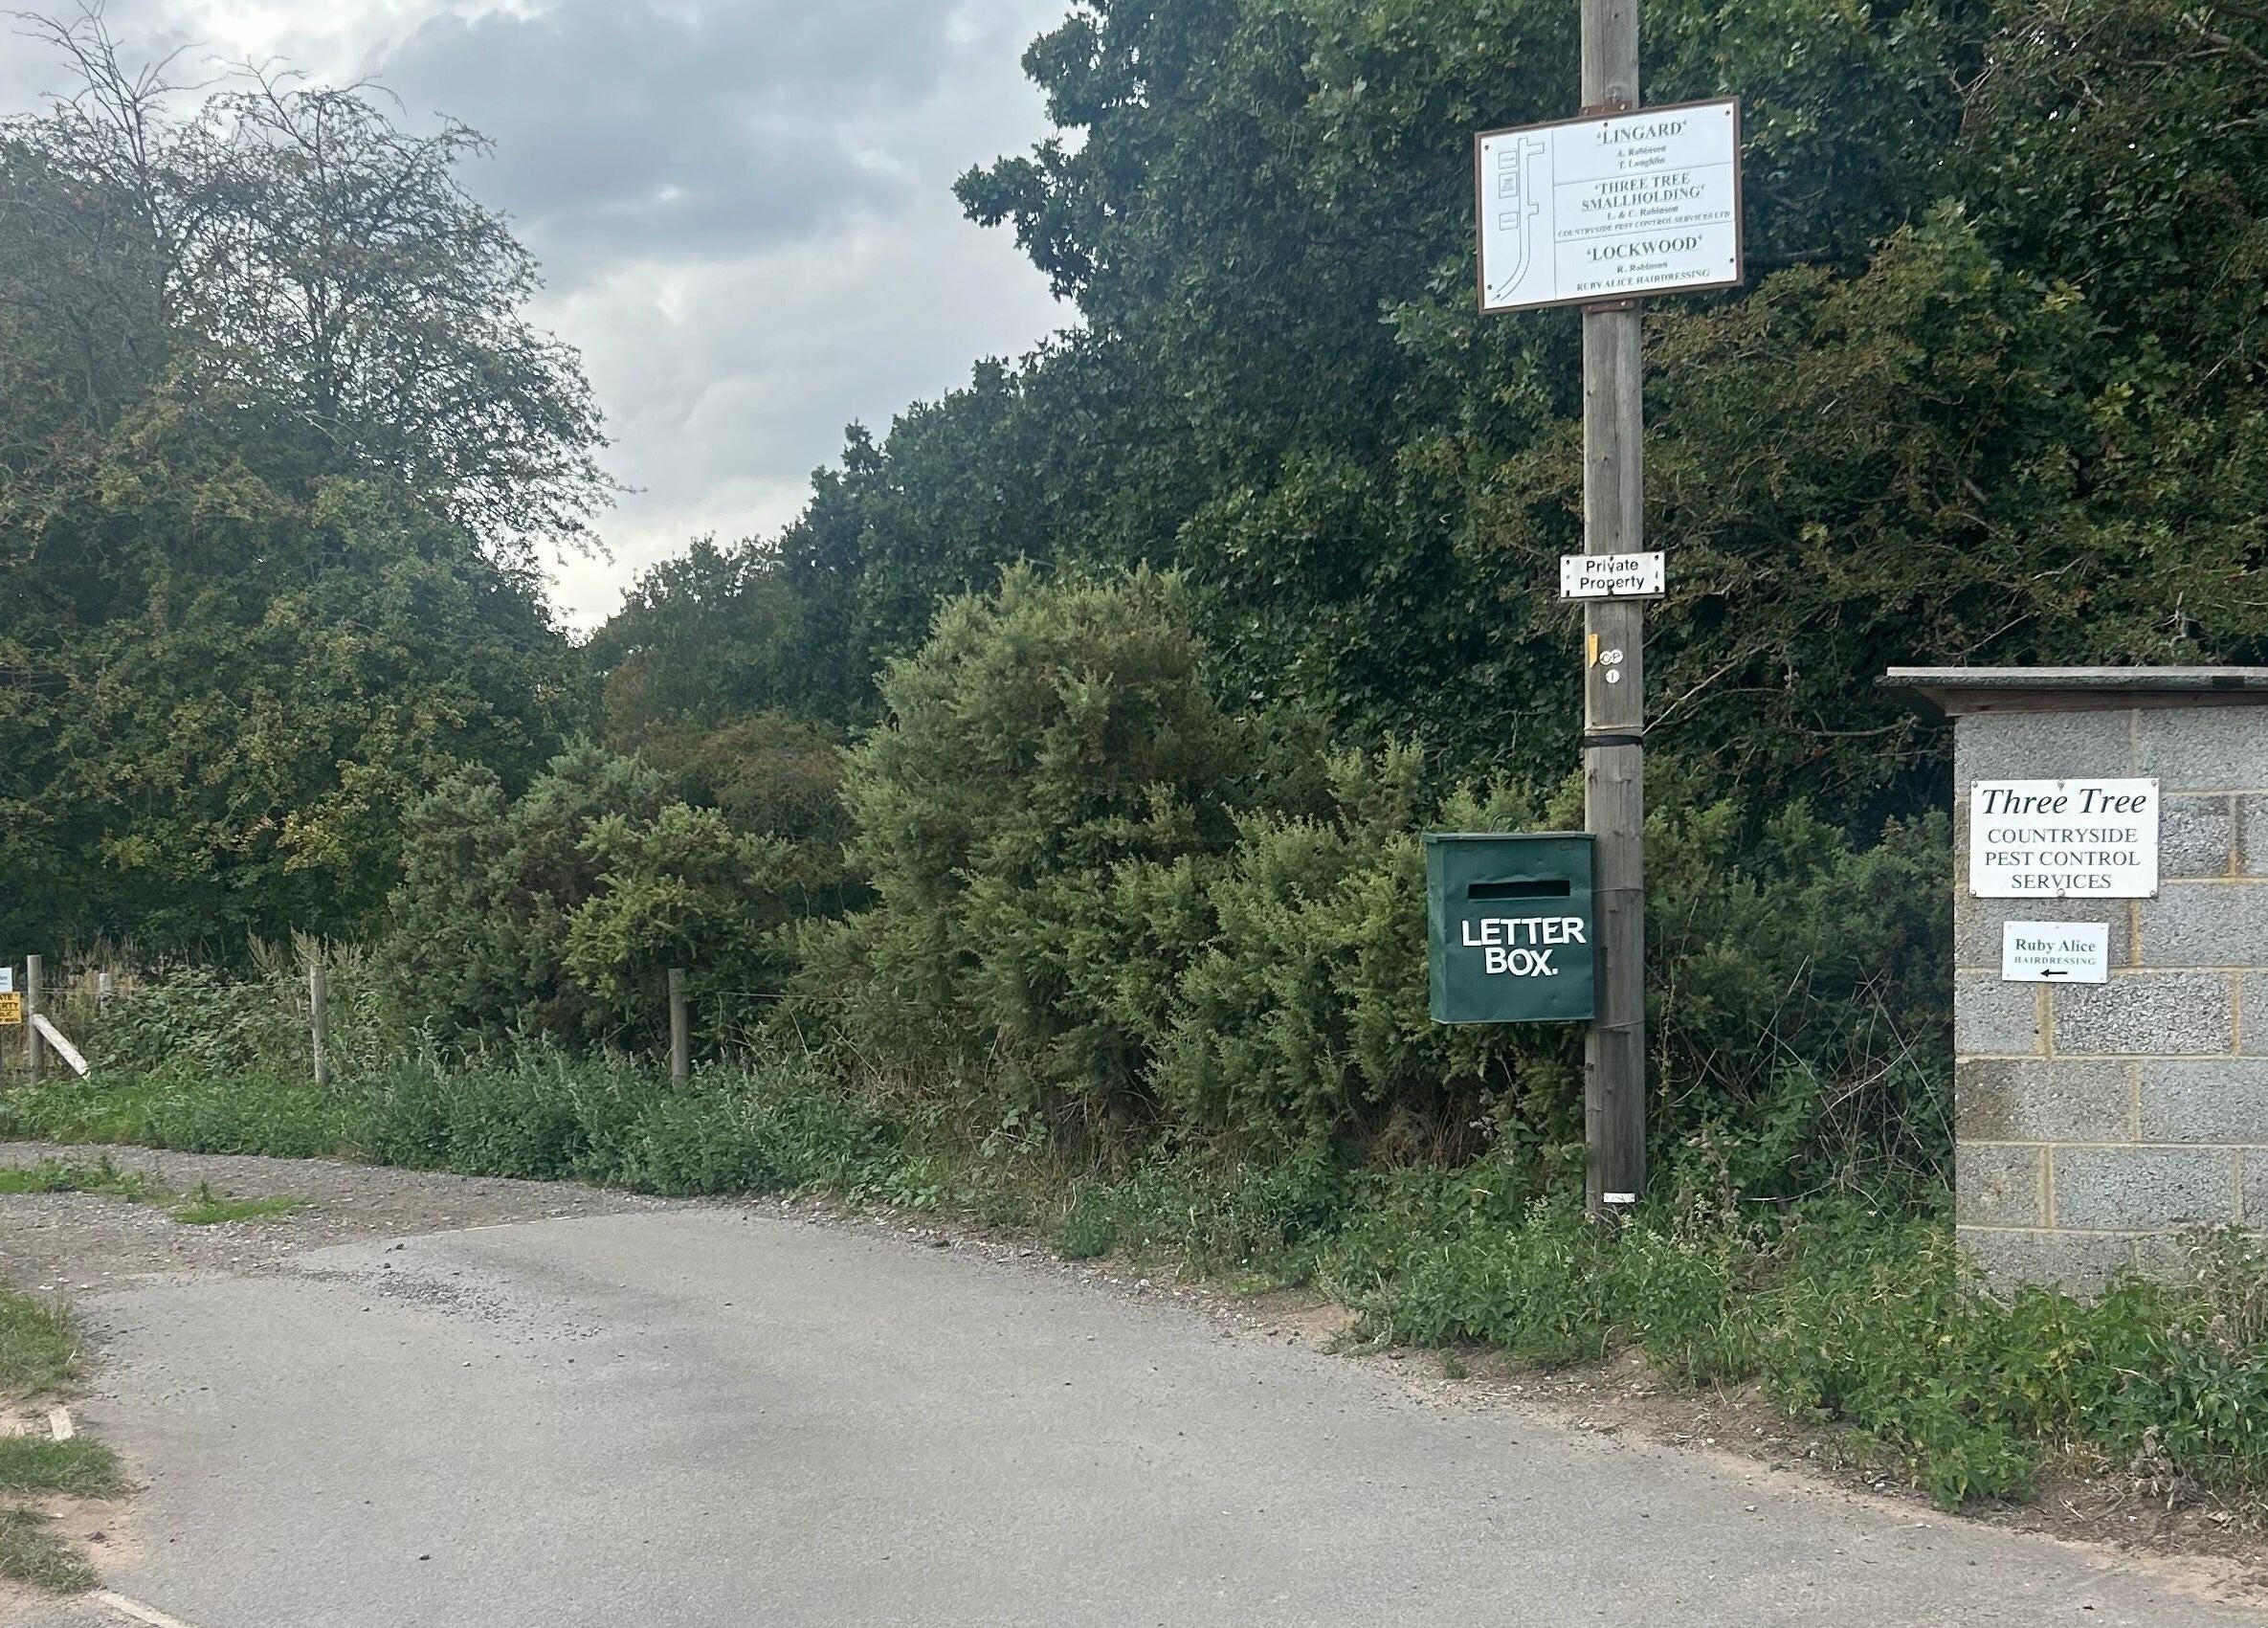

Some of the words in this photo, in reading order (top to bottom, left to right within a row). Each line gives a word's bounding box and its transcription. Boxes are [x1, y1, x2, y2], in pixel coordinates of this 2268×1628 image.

[1653, 172, 1691, 188] TREE
[1617, 211, 1625, 219] &
[1639, 205, 1679, 216] Robinson
[1558, 225, 1612, 237] COUNTRYSIDE
[1614, 221, 1633, 231] PEST
[1634, 218, 1673, 229] CONTROL
[1675, 213, 1713, 223] SERVICES
[1630, 261, 1668, 272] Robinson
[1576, 281, 1602, 291] RUBY
[1604, 278, 1633, 288] ALICE
[1635, 269, 1710, 284] HAIRDRESSING
[1586, 559, 1639, 573] Private
[1580, 576, 1645, 592] Property
[1982, 789, 2068, 814] Three
[2079, 788, 2146, 814] Tree
[1988, 828, 2138, 843] COUNTRYSIDE
[1985, 851, 2035, 866] PEST
[2039, 851, 2141, 866] CONTROL
[2012, 874, 2112, 889] SERVICES
[1461, 916, 1587, 947] LETTER
[2014, 938, 2056, 955] Ruby
[2057, 939, 2097, 952] Alice
[1484, 948, 1560, 977] BOX.
[2014, 956, 2098, 966] HAIRDRESSING
